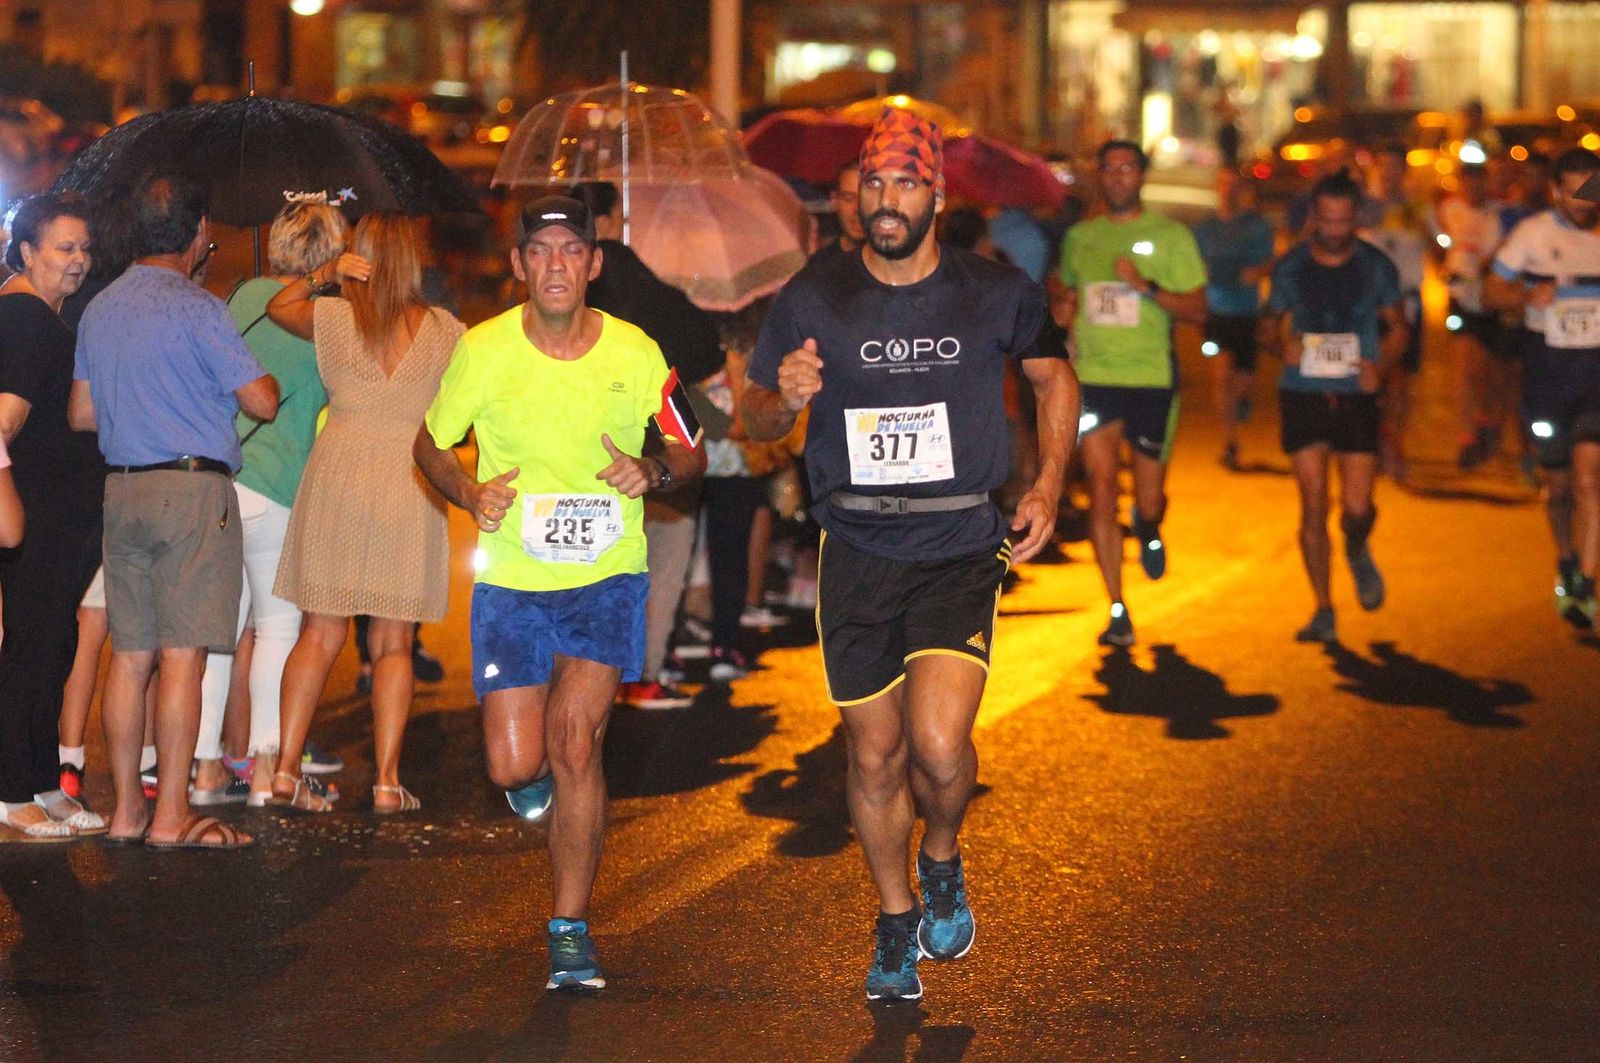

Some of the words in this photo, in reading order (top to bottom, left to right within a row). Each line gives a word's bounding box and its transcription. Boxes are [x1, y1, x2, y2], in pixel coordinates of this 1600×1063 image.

[878, 409, 935, 423] NOCTURNA
[877, 422, 891, 433] DE
[894, 420, 934, 432] HUELVA
[869, 433, 918, 461] 377
[556, 498, 611, 508] NOCTURNA
[554, 508, 569, 517] DE
[571, 507, 611, 518] HUELVA
[544, 517, 594, 545] 235
